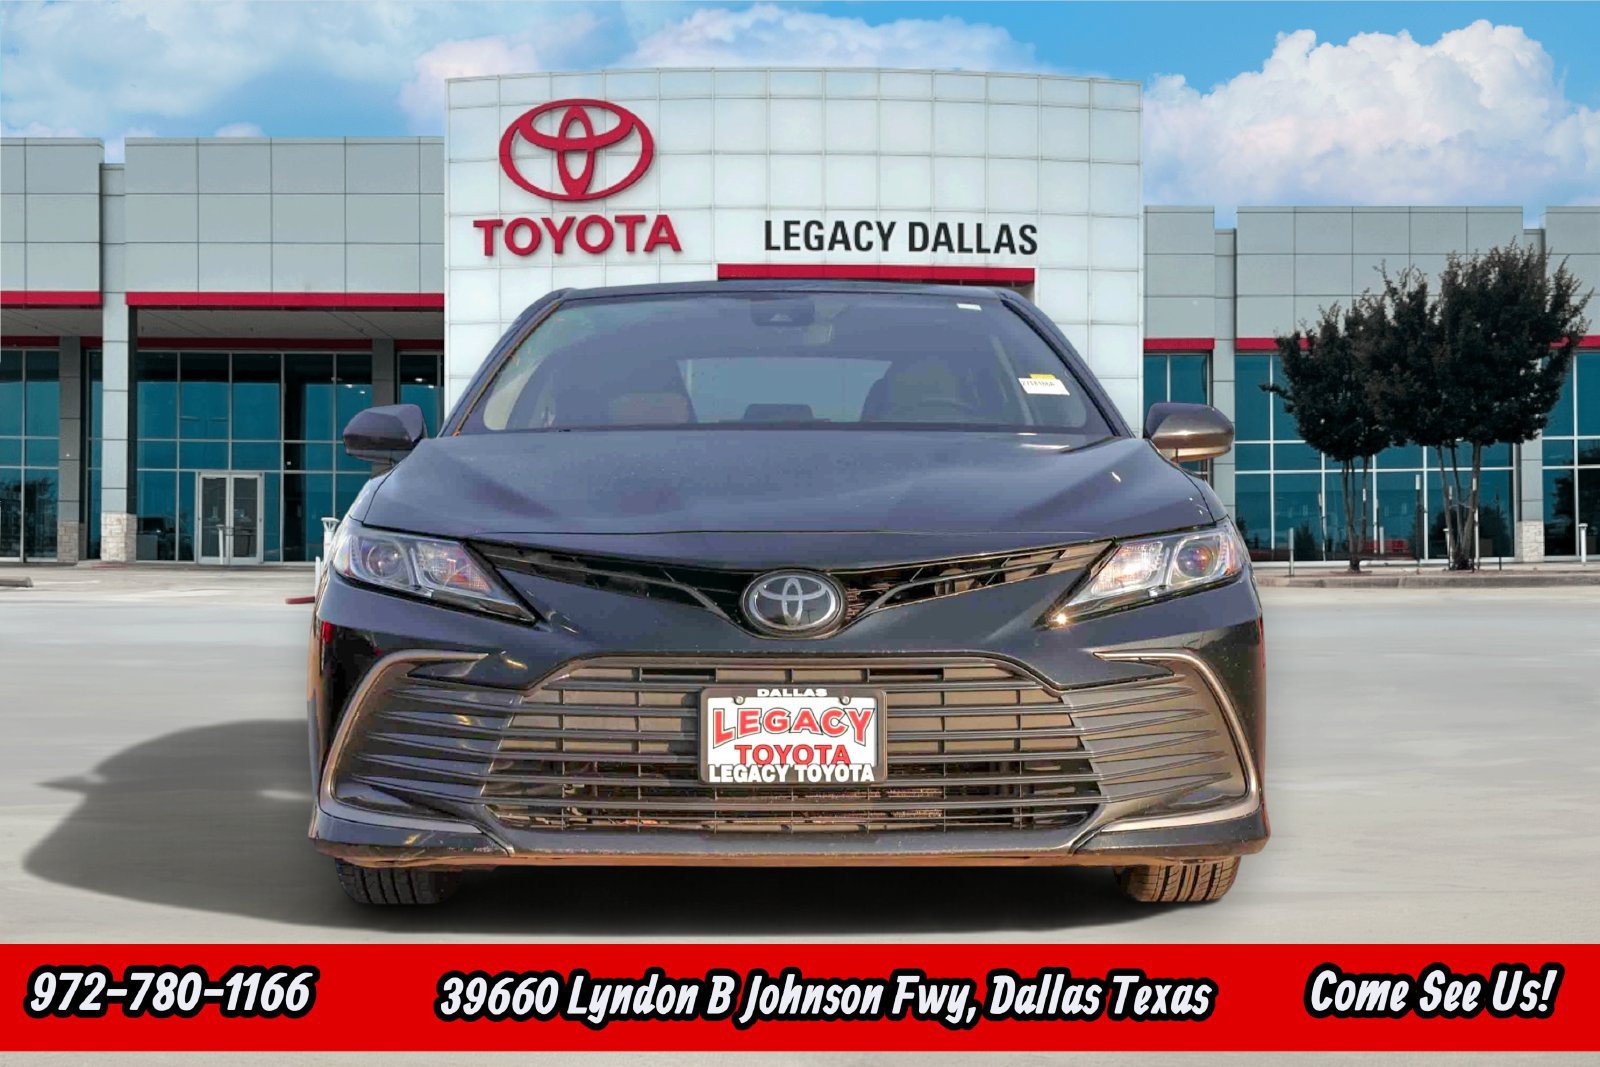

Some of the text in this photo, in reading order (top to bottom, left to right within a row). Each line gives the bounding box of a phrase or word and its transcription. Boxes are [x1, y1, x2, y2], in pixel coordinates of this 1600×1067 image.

[473, 214, 683, 256] TOYOTA
[764, 219, 1038, 255] LEGACY DALLAS
[756, 688, 828, 697] DALLAS
[712, 706, 875, 749] LEGACY
[734, 744, 851, 766] TOYOTA
[708, 764, 875, 783] LEGACY TOYOTA
